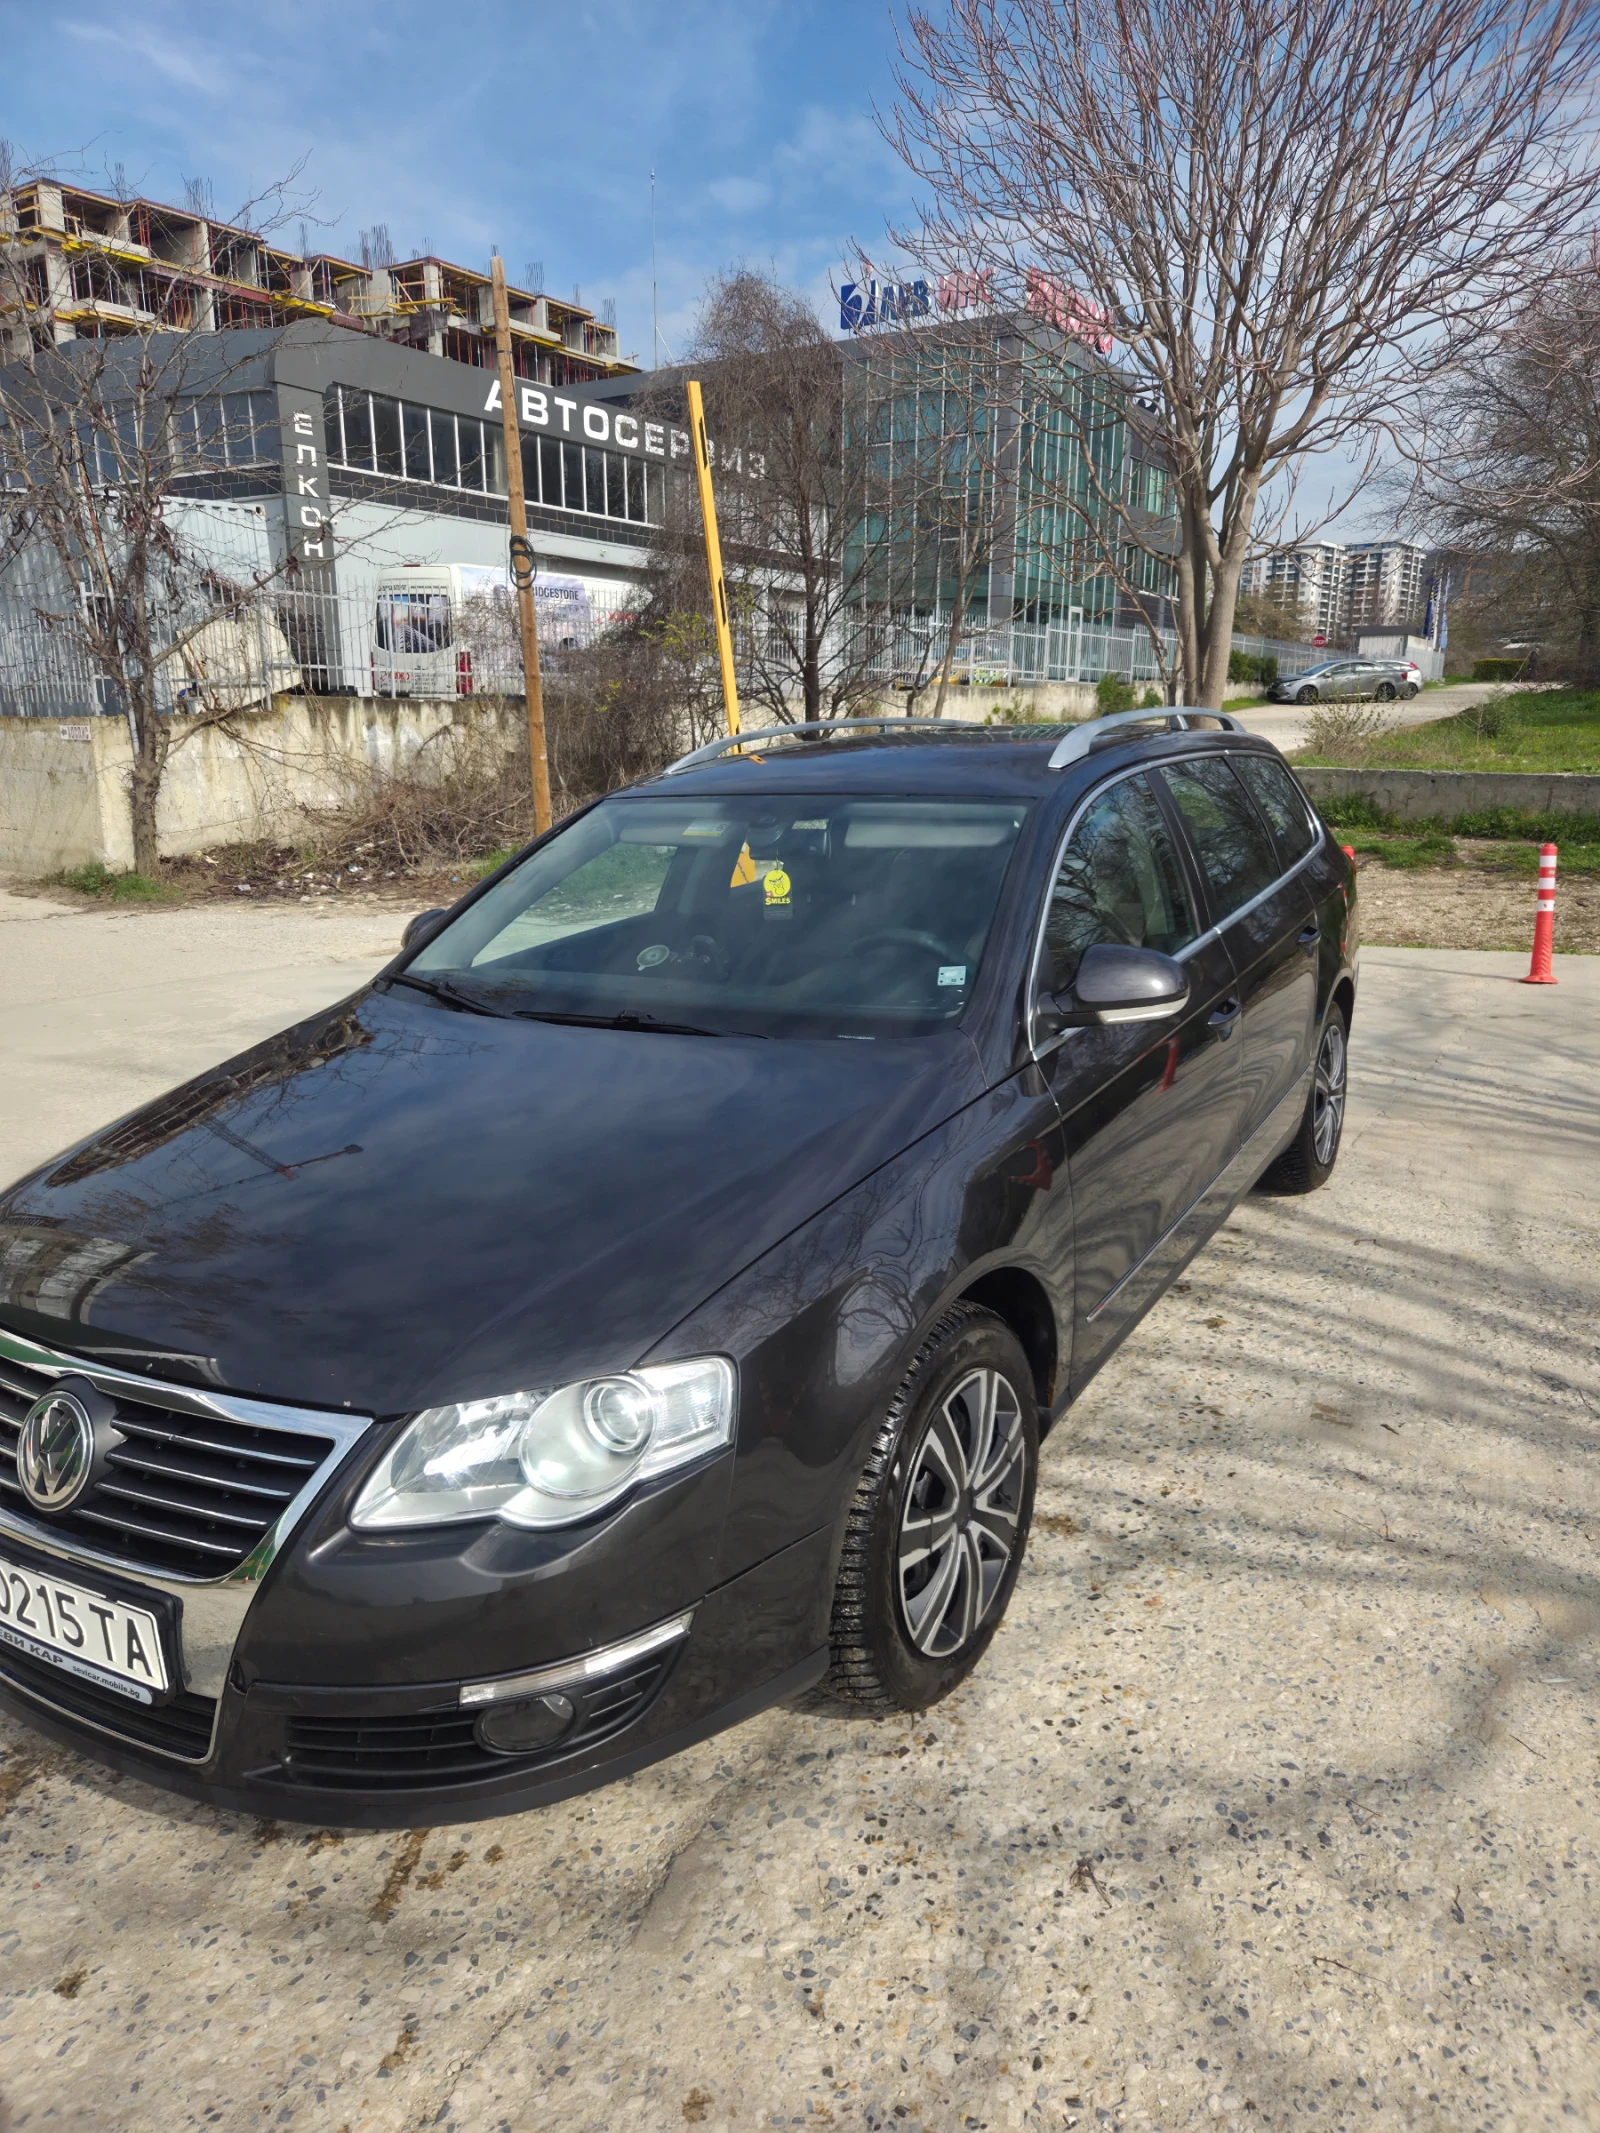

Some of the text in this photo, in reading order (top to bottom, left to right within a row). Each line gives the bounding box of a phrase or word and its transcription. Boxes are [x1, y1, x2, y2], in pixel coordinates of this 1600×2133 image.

[293, 412, 324, 558] ЕЛКОН
[0, 1629, 64, 1664] ВИ КАР
[72, 1665, 141, 1699] sevicar.mobile.bg
